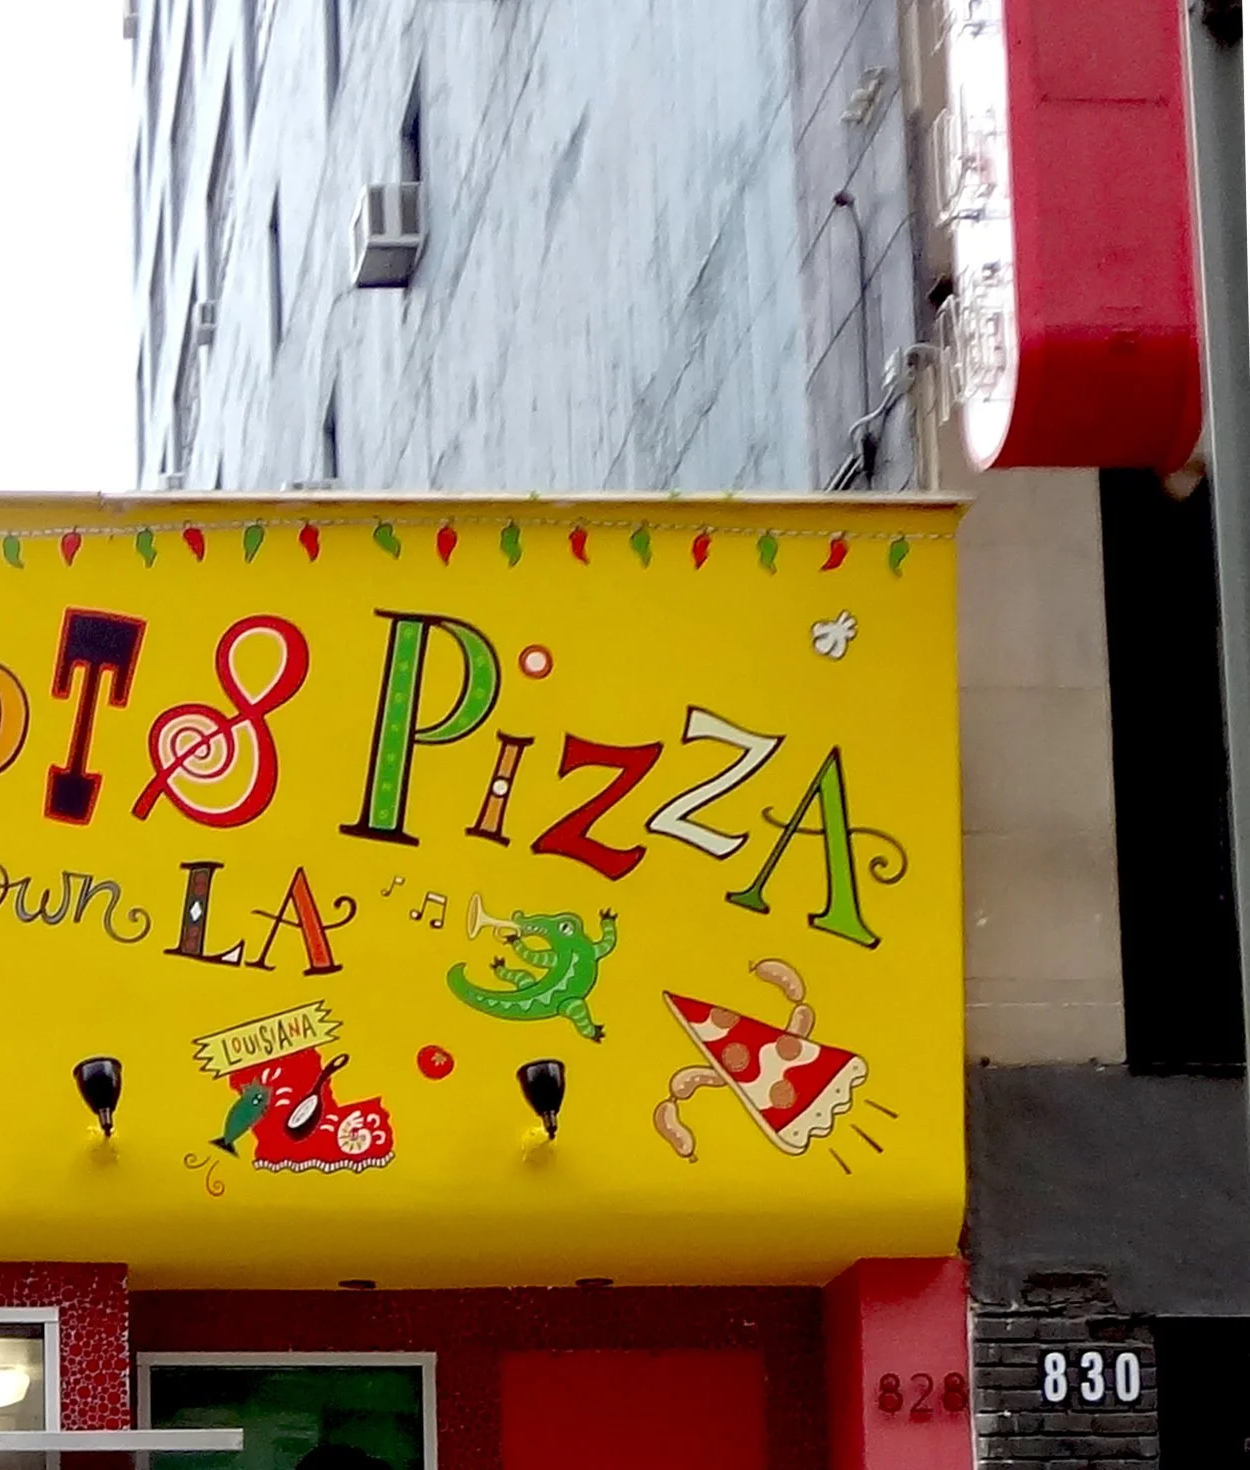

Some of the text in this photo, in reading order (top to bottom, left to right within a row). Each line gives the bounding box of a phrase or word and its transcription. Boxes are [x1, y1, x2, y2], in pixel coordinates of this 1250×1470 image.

[163, 860, 357, 976] LA
[221, 1013, 317, 1066] LOUISIANA
[876, 1371, 970, 1416] 828
[1043, 1351, 1141, 1403] 830
